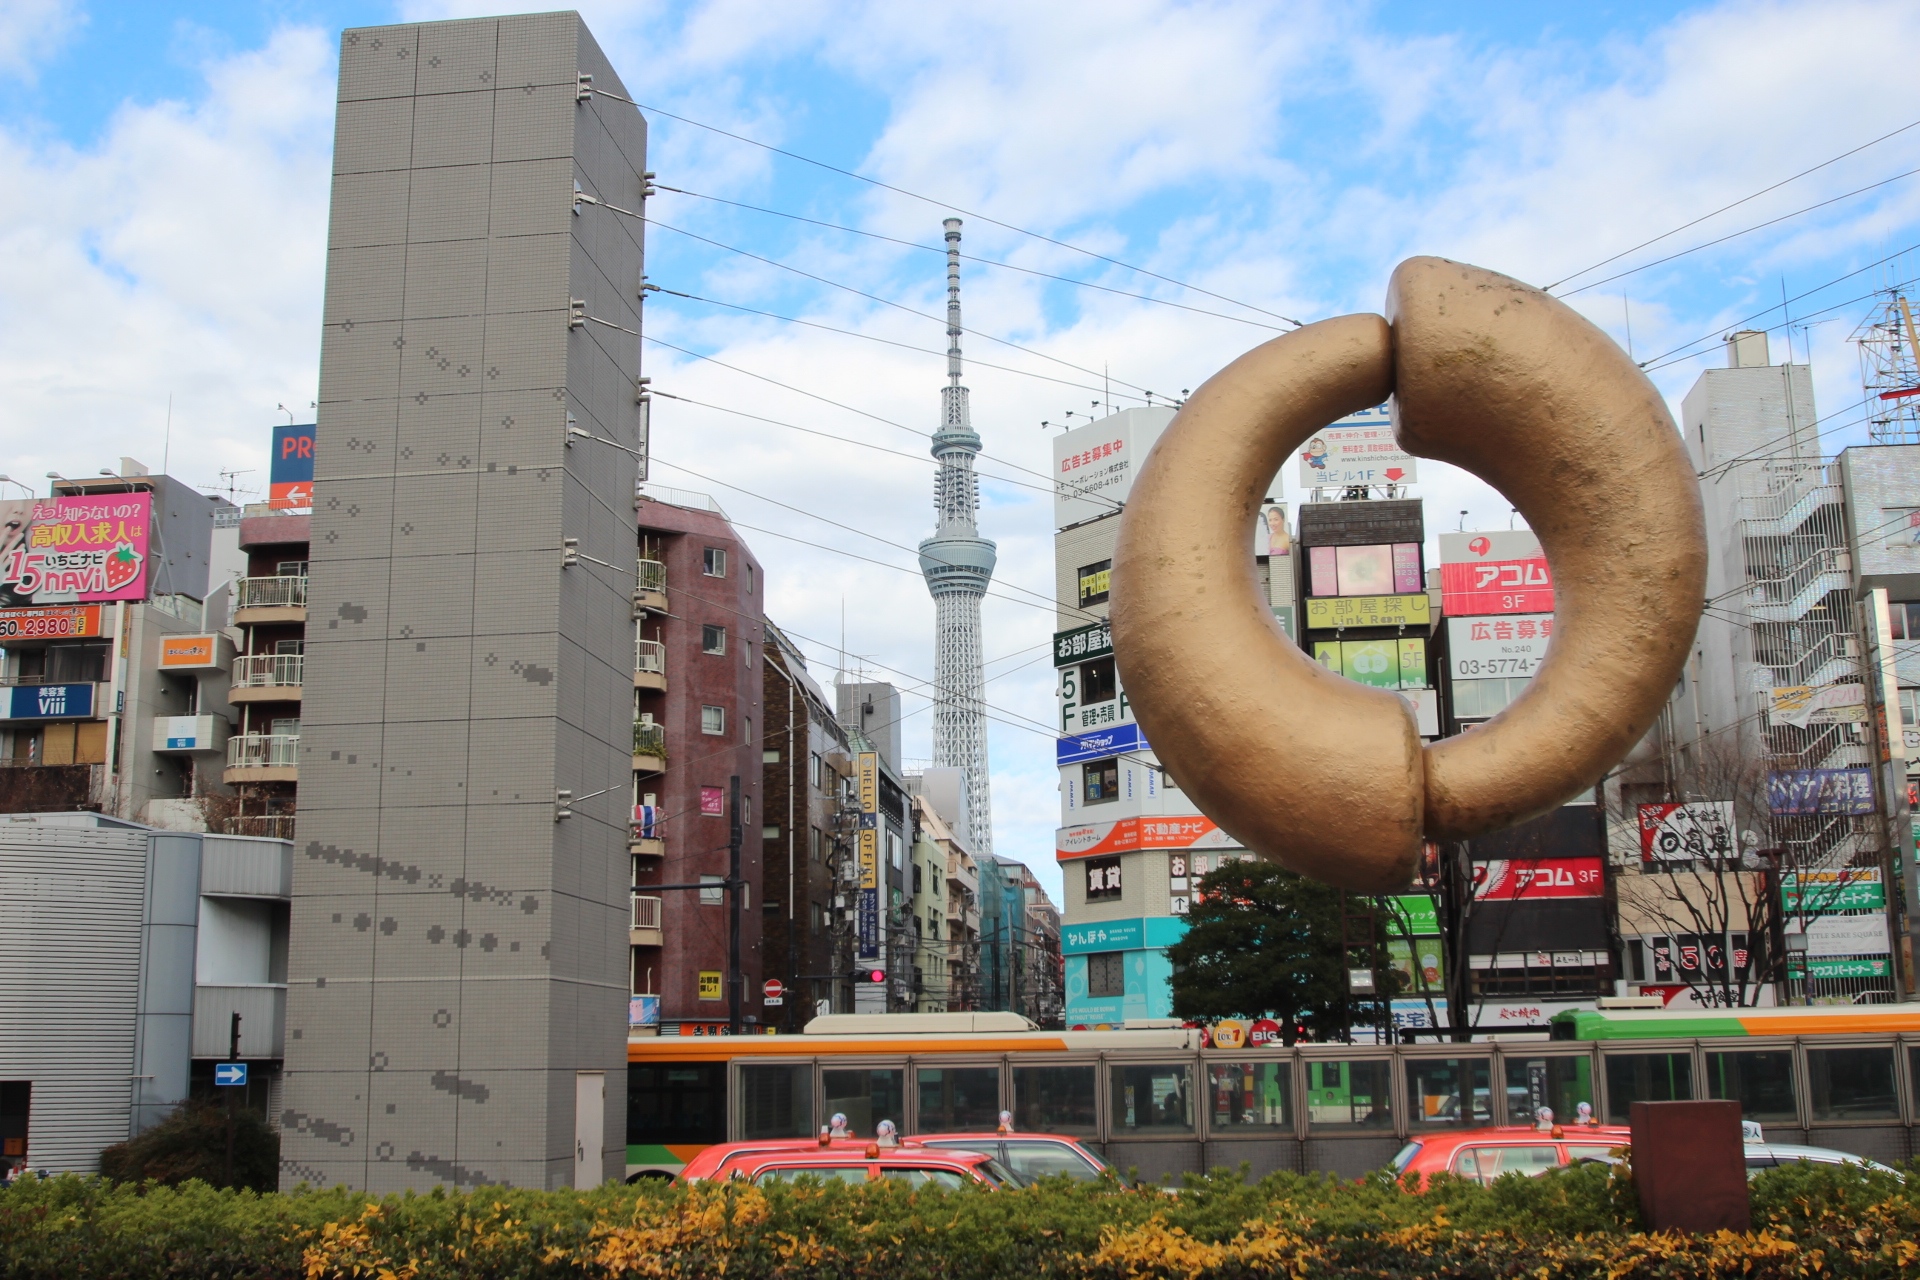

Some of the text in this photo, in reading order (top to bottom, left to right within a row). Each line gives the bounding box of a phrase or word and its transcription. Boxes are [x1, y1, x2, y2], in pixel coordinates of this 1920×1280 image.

[1061, 439, 1123, 473] 広告主募集中
[1316, 470, 1376, 483] 当ビル1F
[31, 521, 143, 547] 高収入求人は
[45, 552, 104, 566] いちごナビ
[5, 551, 45, 592] 15
[1475, 563, 1549, 589] アコム
[1311, 597, 1426, 615] お部屋探し
[1502, 594, 1525, 609] 3F
[1332, 615, 1364, 626] Link
[1501, 646, 1531, 654] No.240
[1402, 651, 1423, 669] 5F
[1459, 658, 1543, 675] 03-5774-
[38, 687, 67, 697] 美容室
[38, 697, 66, 715] Viii
[1081, 704, 1115, 727] 管理・売買
[863, 769, 872, 810] HELLO
[1143, 822, 1204, 836] 不動産ナビ
[1089, 866, 1121, 891] 賃貸
[1515, 868, 1599, 889] アコム 3F
[1068, 929, 1107, 946] なんぼや
[1831, 931, 1851, 939] SAKE
[1852, 930, 1883, 939] SQUARE
[700, 976, 720, 984] お部屋
